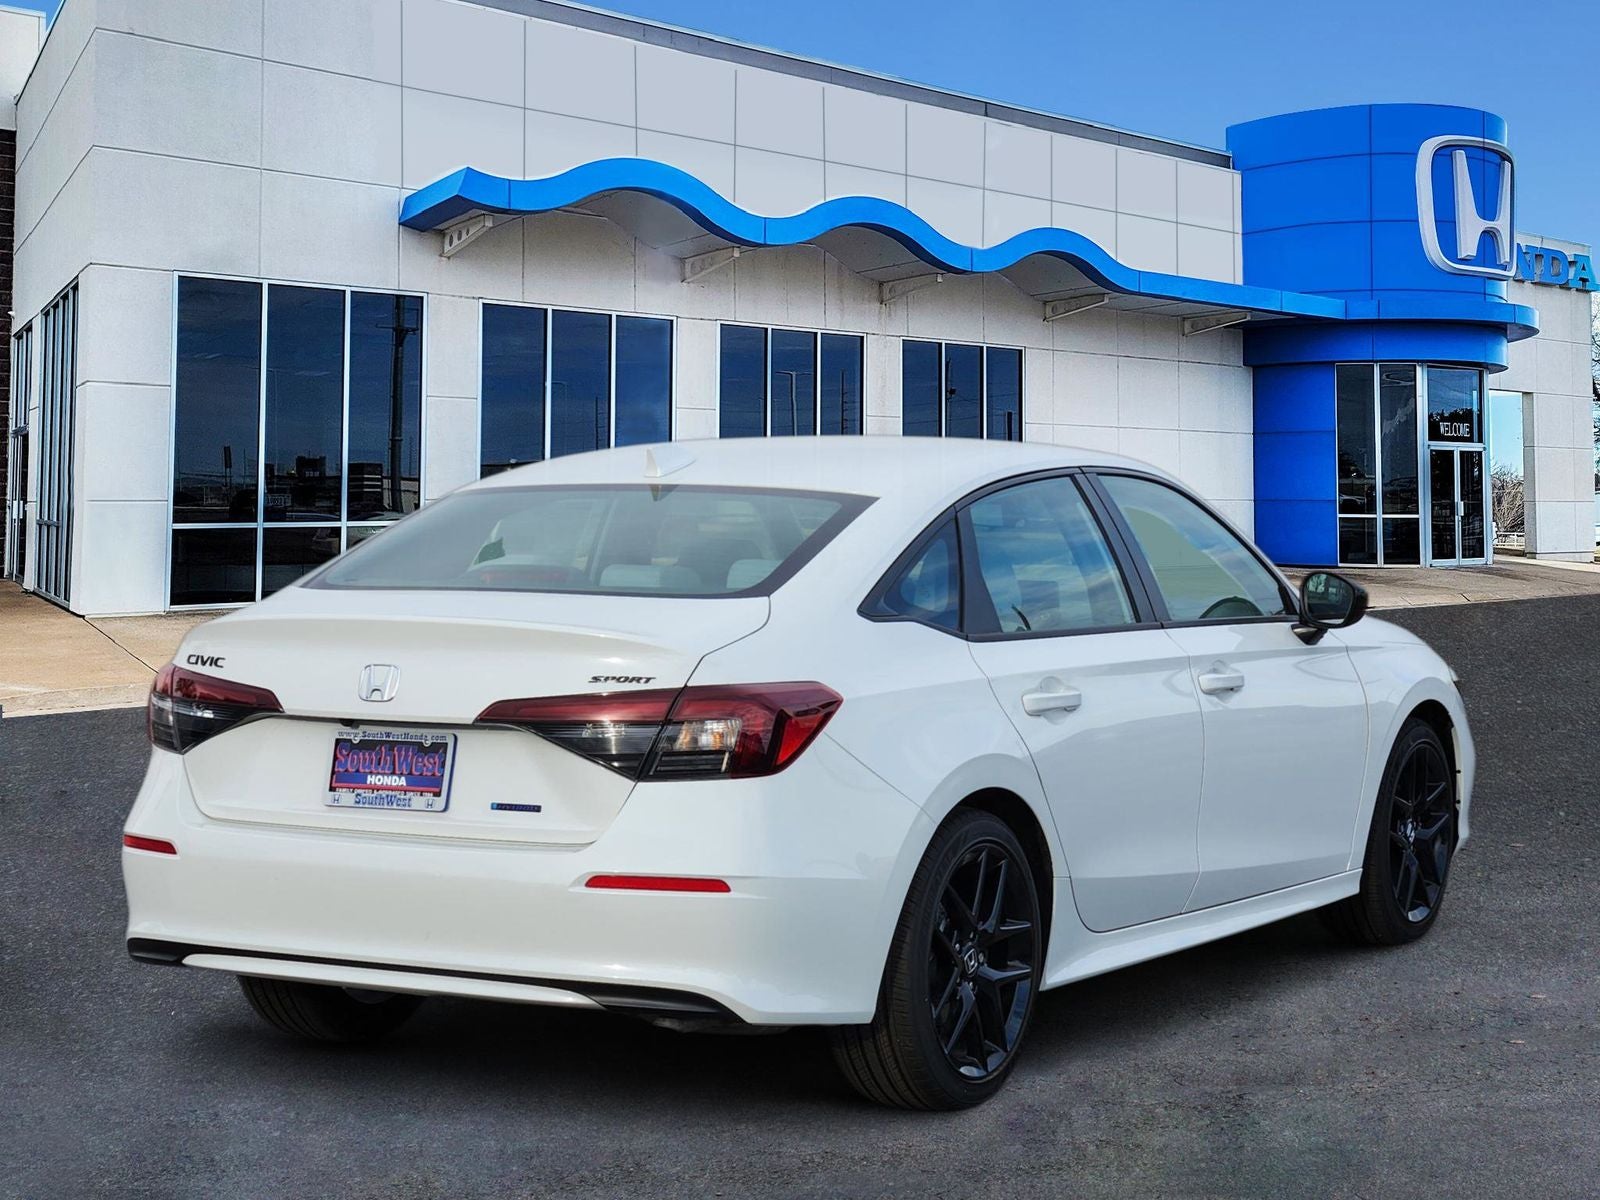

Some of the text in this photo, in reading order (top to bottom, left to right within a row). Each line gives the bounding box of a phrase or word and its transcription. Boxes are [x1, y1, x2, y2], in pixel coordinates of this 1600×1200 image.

[1440, 422, 1471, 437] WELCOME
[187, 654, 226, 668] CIVIC
[588, 675, 656, 685] SPORT
[366, 774, 407, 787] HONDA
[353, 792, 412, 808] SouthWest
